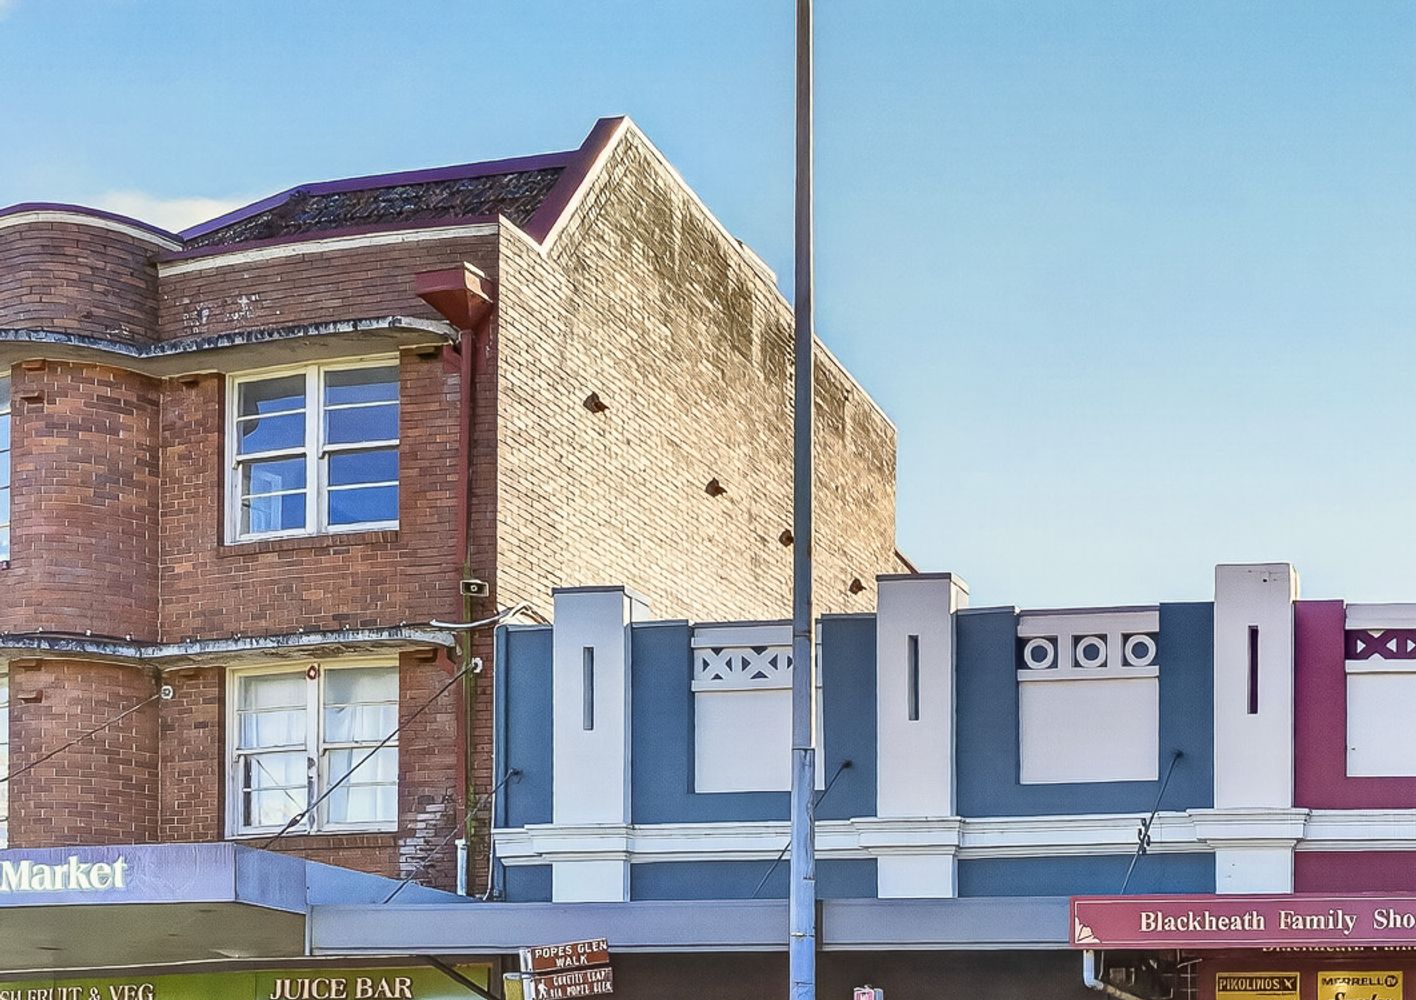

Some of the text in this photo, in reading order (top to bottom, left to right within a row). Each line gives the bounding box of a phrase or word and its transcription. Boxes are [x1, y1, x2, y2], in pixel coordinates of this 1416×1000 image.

[0, 855, 127, 892] Market
[1139, 911, 1265, 932] Blackheath
[1278, 909, 1357, 935] Family
[535, 940, 608, 959] POPES GLEN
[555, 954, 588, 968] WALK
[270, 977, 412, 1000] JUICE BAR
